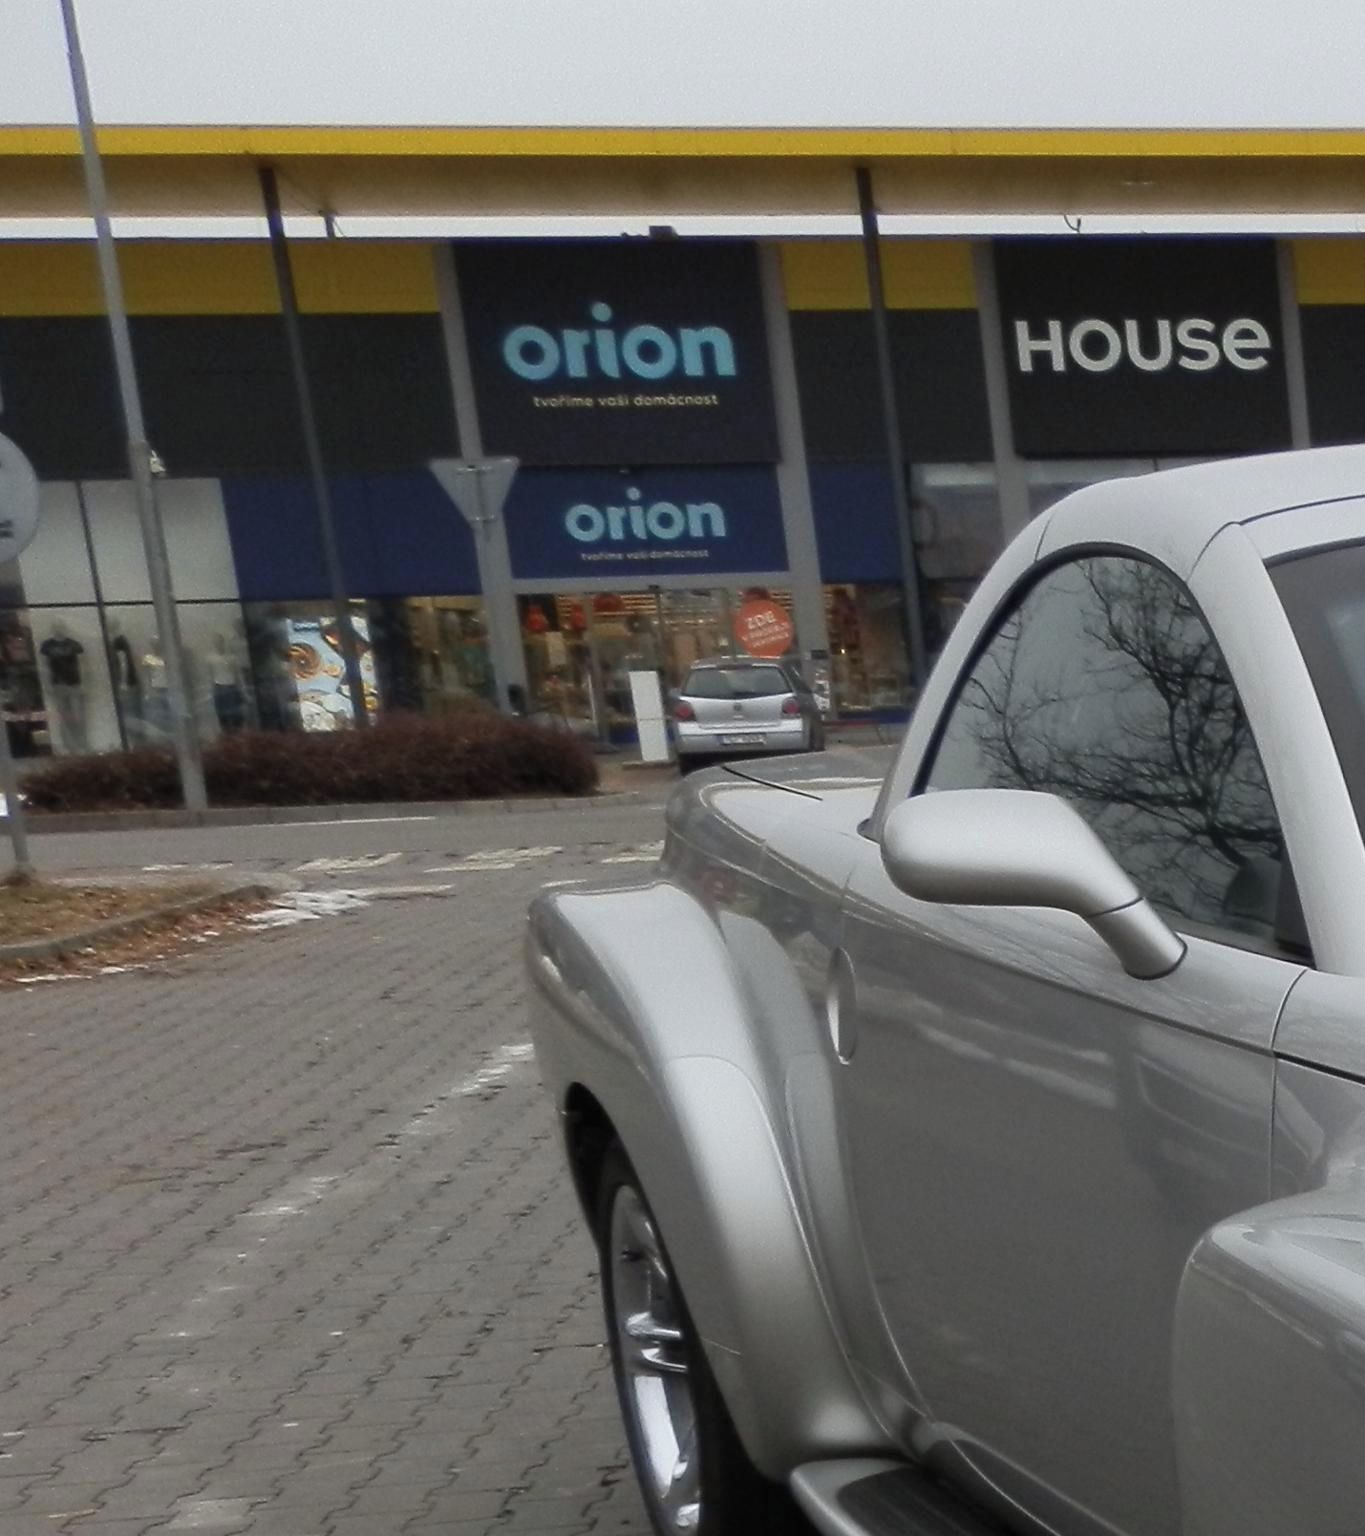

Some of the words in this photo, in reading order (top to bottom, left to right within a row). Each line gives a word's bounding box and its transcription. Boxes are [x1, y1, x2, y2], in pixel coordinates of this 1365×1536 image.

[503, 302, 737, 381] orion
[633, 392, 720, 406] domácnost
[564, 486, 727, 542] orion
